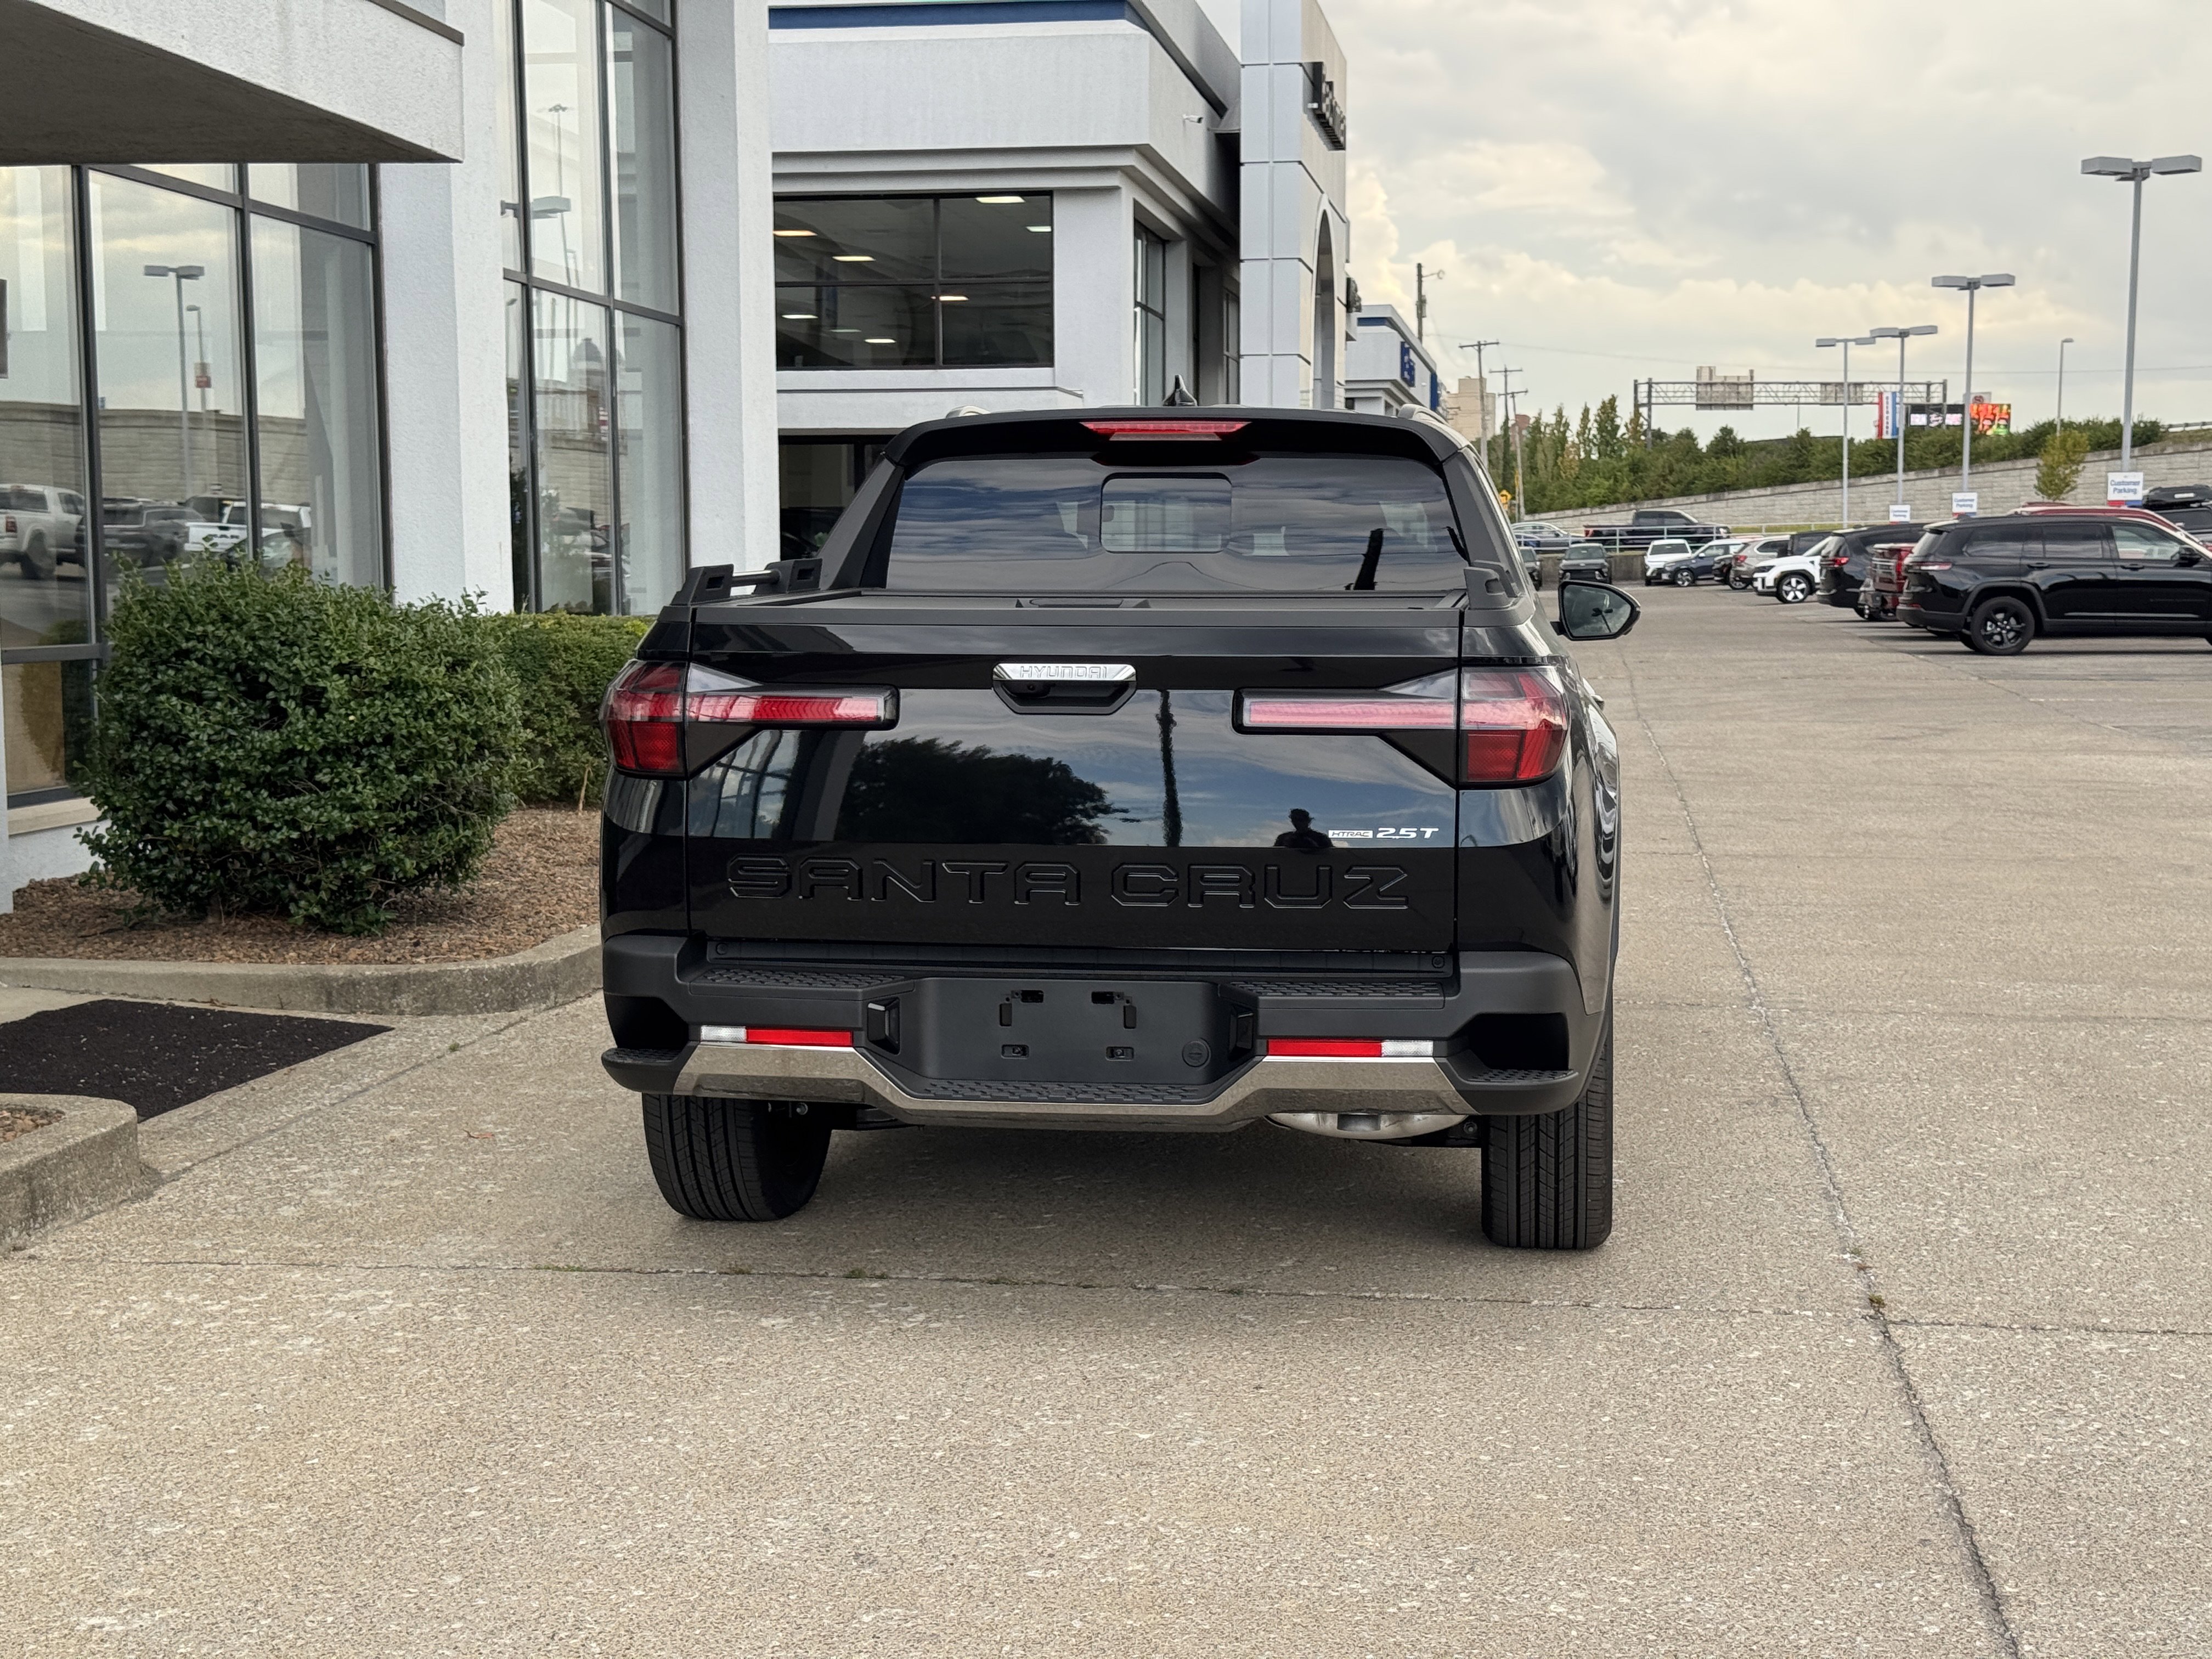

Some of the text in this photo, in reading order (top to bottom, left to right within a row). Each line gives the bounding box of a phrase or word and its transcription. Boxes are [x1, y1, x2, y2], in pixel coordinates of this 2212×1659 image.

[1019, 665, 1107, 679] HYUNDAI
[727, 854, 1409, 910] SANTA CRUZ
